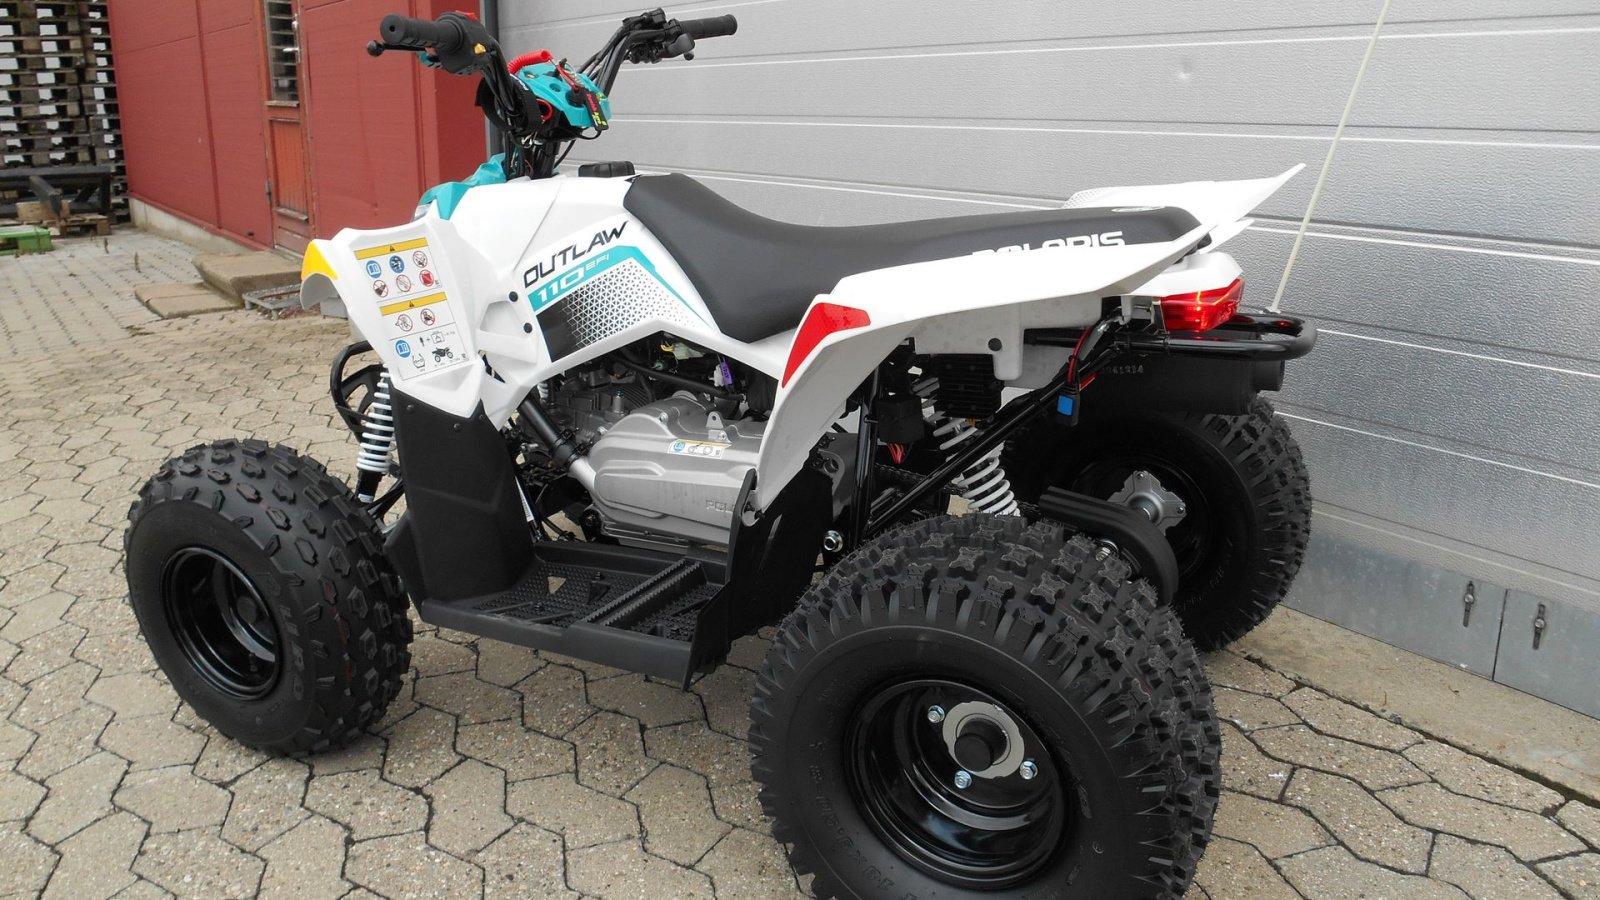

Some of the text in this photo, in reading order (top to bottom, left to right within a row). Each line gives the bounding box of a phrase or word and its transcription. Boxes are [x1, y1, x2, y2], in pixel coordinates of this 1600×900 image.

[523, 220, 628, 288] OUTLAW
[537, 266, 586, 303] 110
[705, 499, 736, 513] POL
